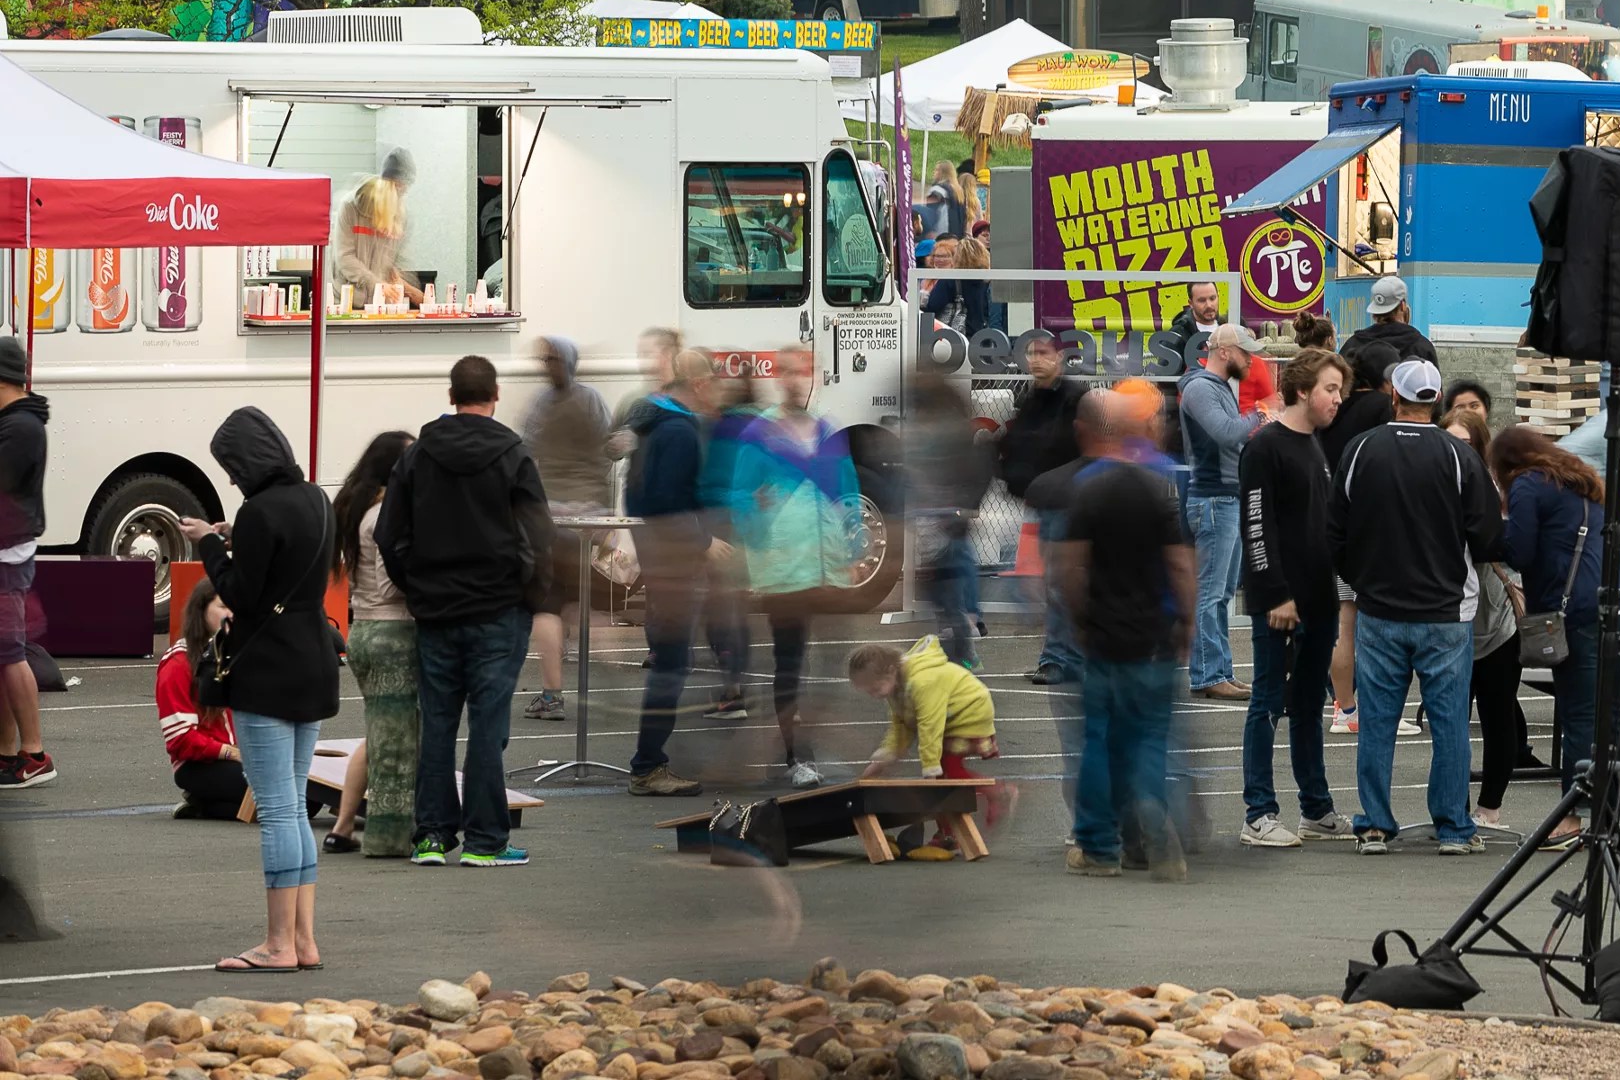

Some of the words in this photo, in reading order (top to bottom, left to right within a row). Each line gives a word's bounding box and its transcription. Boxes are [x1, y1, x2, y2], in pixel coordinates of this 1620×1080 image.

[602, 20, 633, 47] BEER
[649, 20, 682, 47] BEER
[698, 21, 731, 47] BEER
[747, 21, 779, 48] BEER
[795, 21, 827, 49] BEER
[843, 21, 874, 49] BEER
[1036, 55, 1072, 72] MAUI
[1489, 93, 1531, 123] MENU
[162, 131, 183, 139] FEISTY
[1048, 148, 1215, 219] MOUTH
[145, 202, 169, 223] Diet
[168, 192, 219, 231] Coke
[1056, 193, 1222, 249] WATERING
[1063, 224, 1230, 302] PIZZA
[142, 338, 170, 347] naturally
[172, 338, 200, 347] flavored
[839, 340, 864, 350] SDOT
[867, 340, 897, 350] 103485
[840, 329, 852, 338] OT
[854, 329, 873, 338] FOR
[875, 329, 897, 338] HIRE
[920, 312, 1213, 376] because
[725, 353, 773, 377] Coke
[1248, 487, 1262, 521] TRUST
[1248, 523, 1264, 539] NO
[1251, 541, 1269, 572] SUITS
